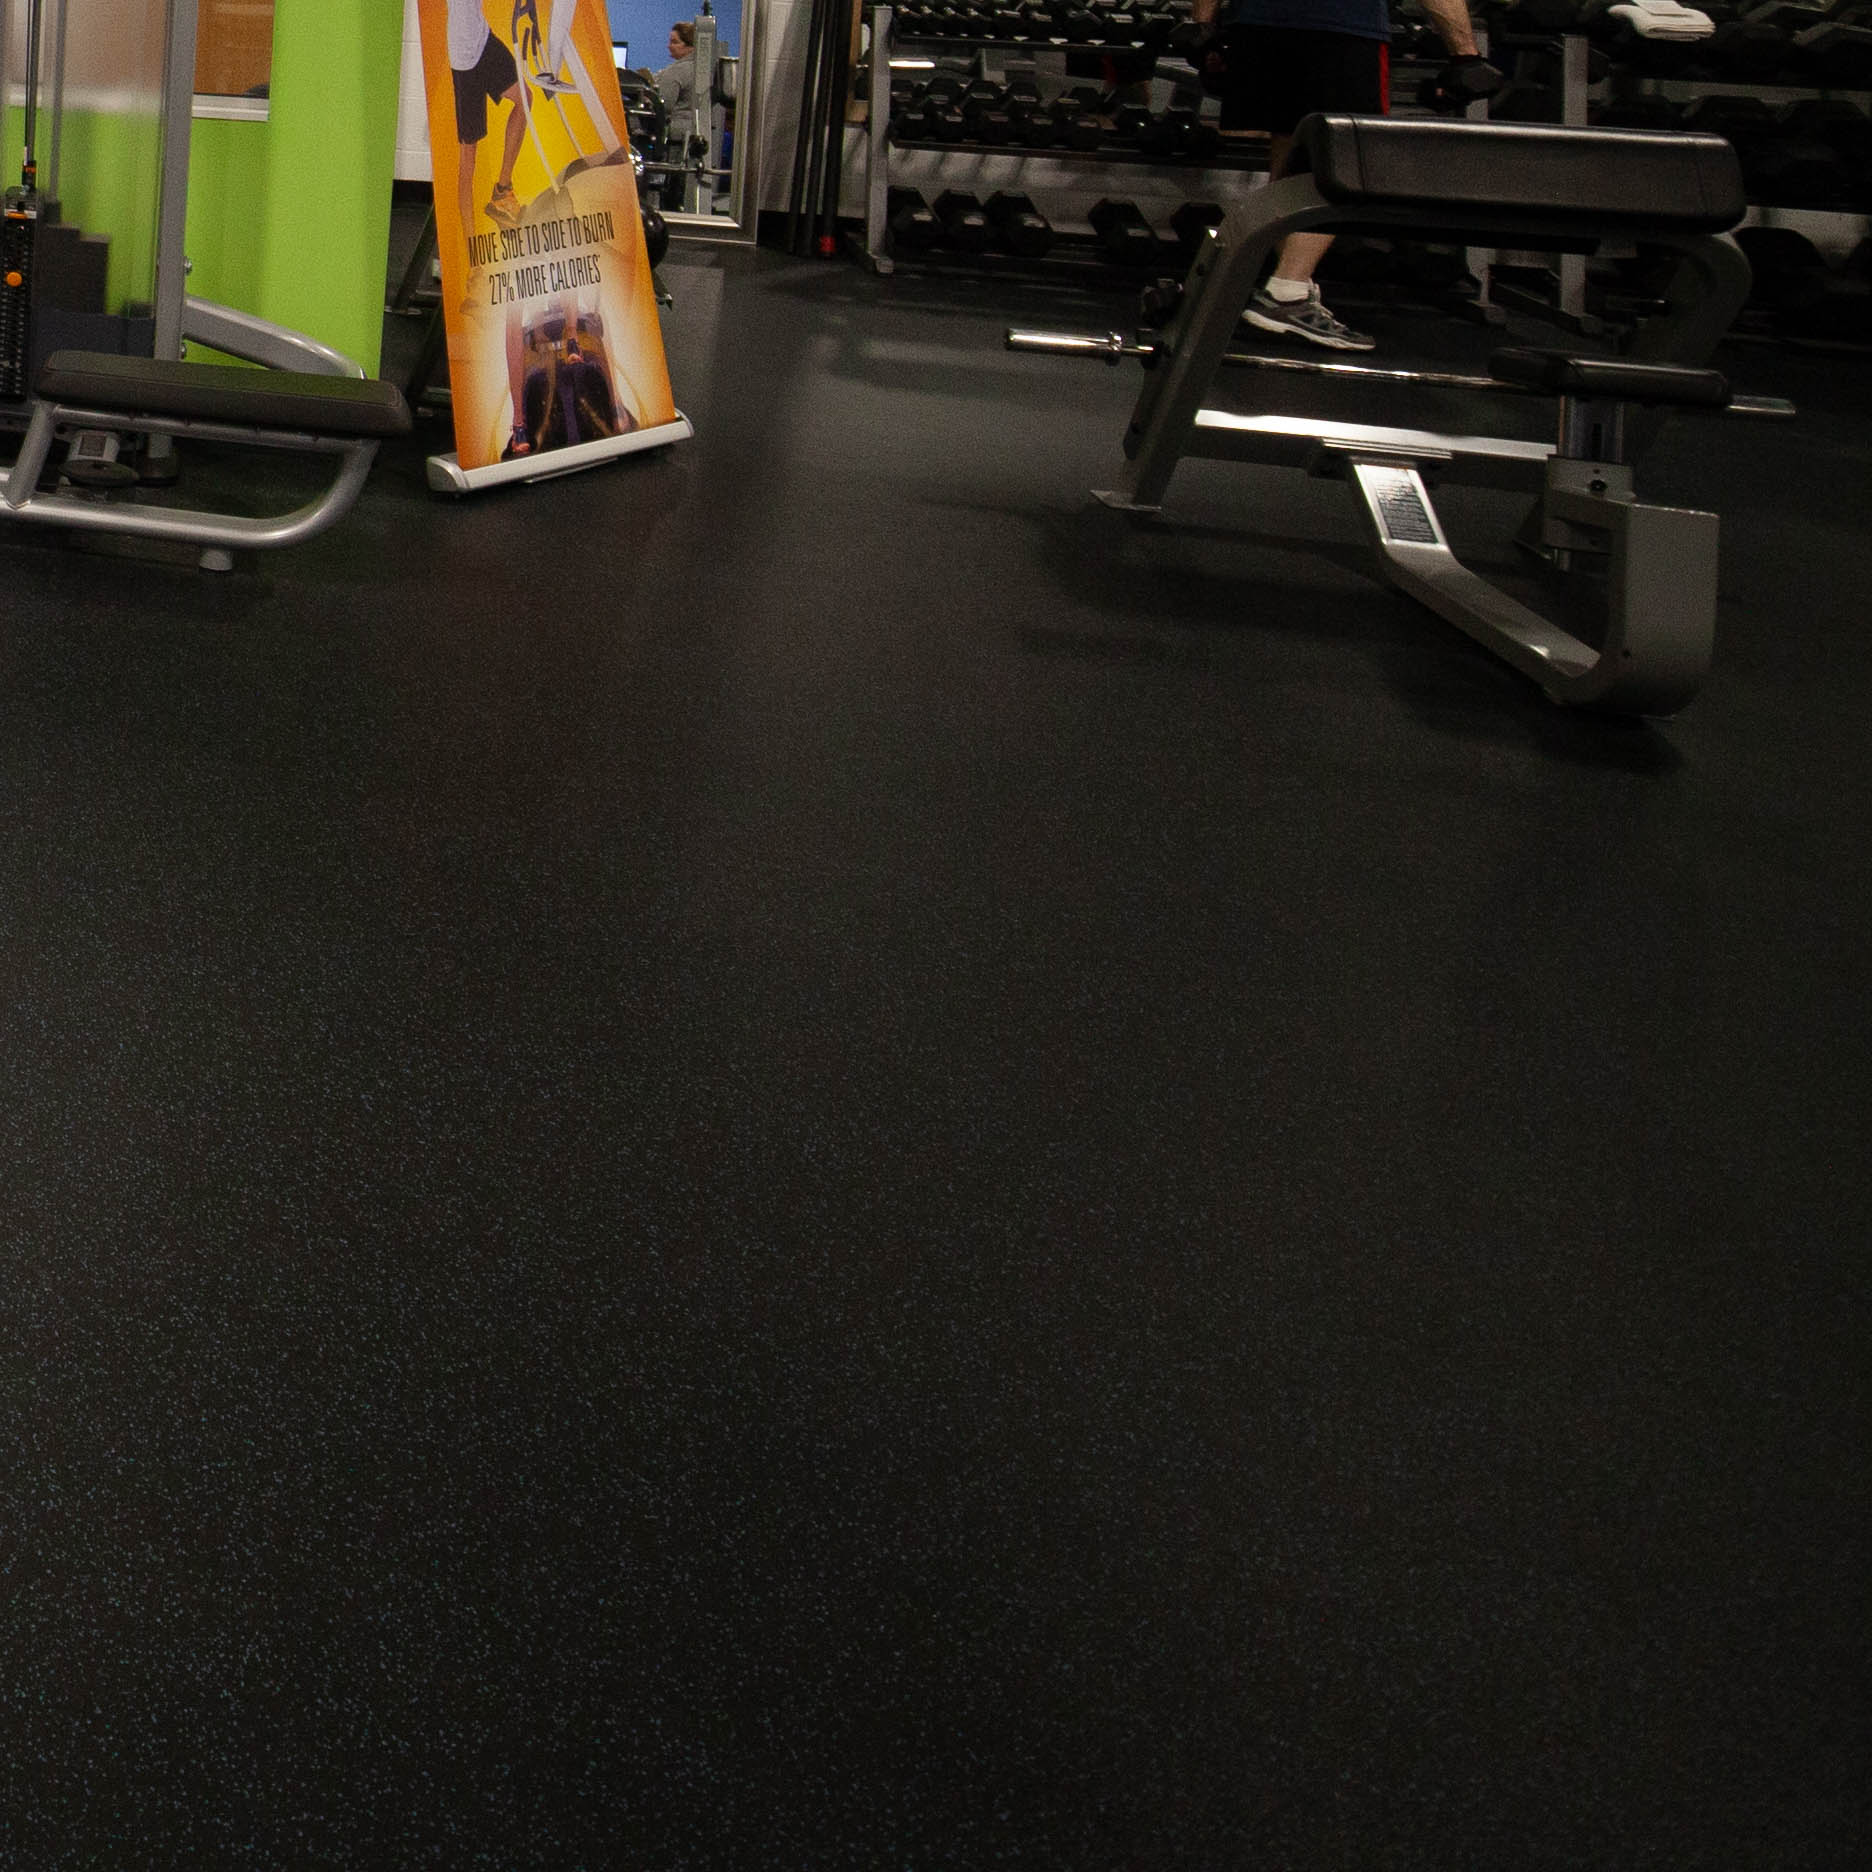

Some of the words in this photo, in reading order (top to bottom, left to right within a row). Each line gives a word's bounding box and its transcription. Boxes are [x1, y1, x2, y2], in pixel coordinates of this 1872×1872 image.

[468, 232, 499, 267] MOVE
[499, 227, 526, 261] SIDE
[525, 224, 541, 255] TO
[541, 219, 567, 253] SIDE
[566, 216, 582, 247] TO
[582, 211, 615, 245] BURN
[489, 271, 515, 306] 27%
[515, 264, 548, 299] MORE
